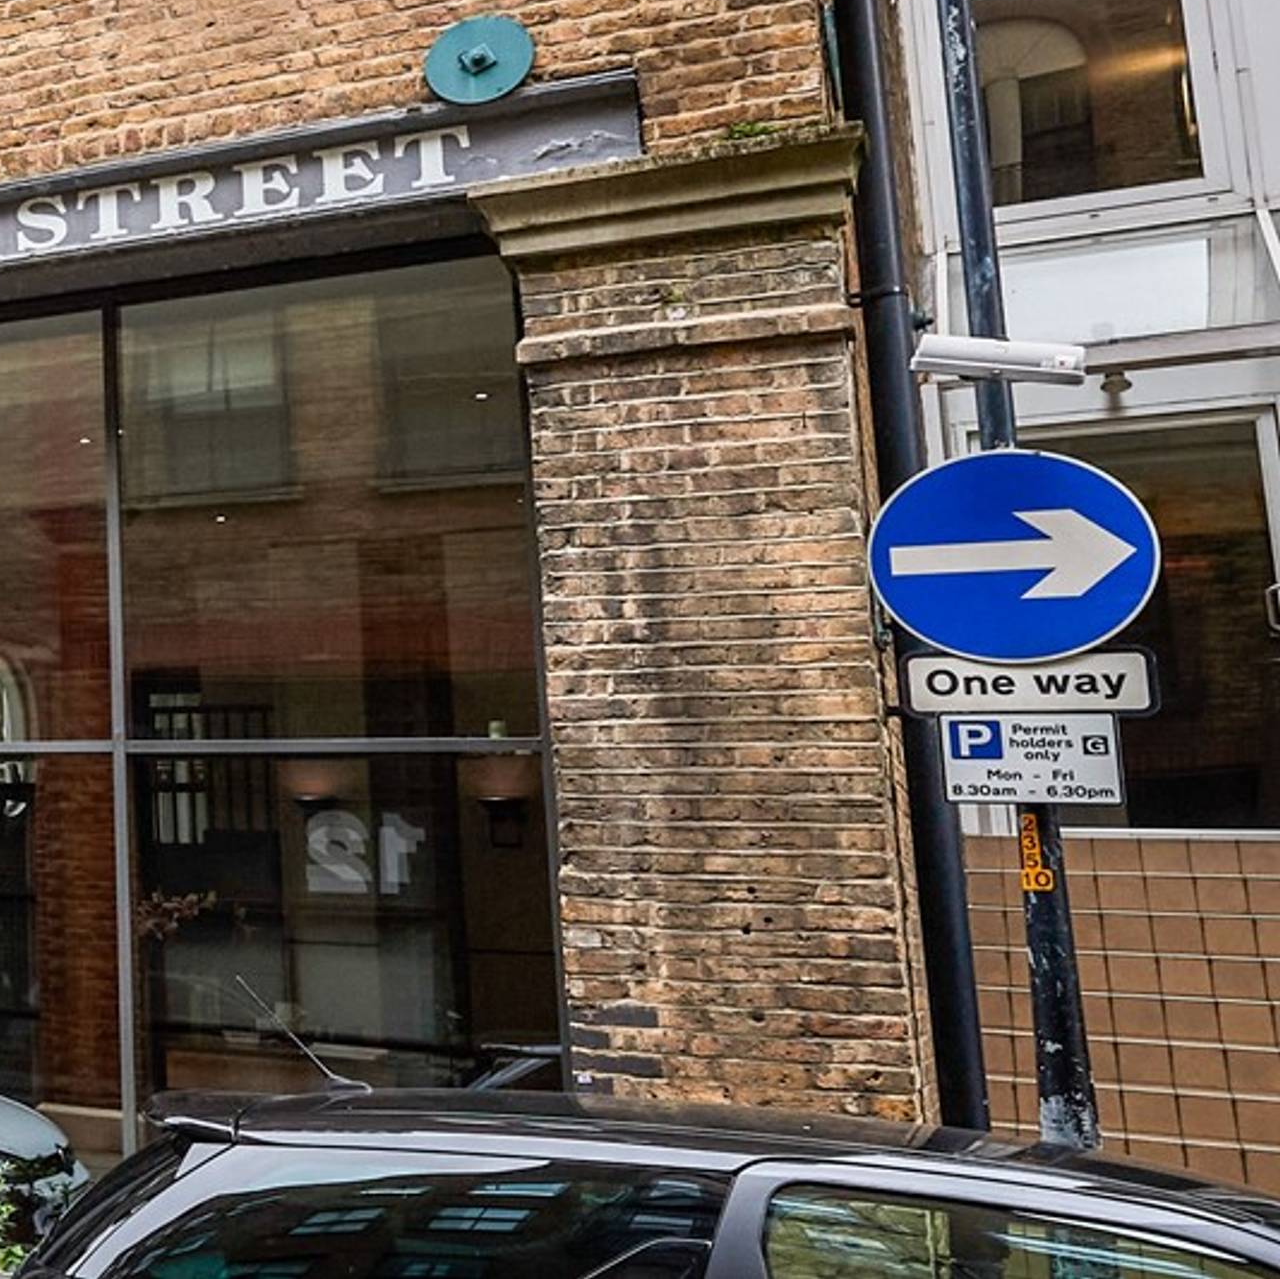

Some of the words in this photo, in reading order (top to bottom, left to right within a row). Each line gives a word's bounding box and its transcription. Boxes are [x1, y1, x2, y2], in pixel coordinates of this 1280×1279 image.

[14, 125, 472, 255] STREET
[926, 669, 1016, 697] One
[1033, 673, 1127, 699] way
[1011, 724, 1068, 736] Permit
[958, 724, 993, 757] P
[1009, 738, 1073, 748] holders
[1023, 750, 1061, 762] only
[987, 770, 1023, 781] Mon
[1052, 770, 1075, 781] Fri
[952, 784, 1018, 797] 8.30am
[1046, 786, 1116, 800] 6.30pm
